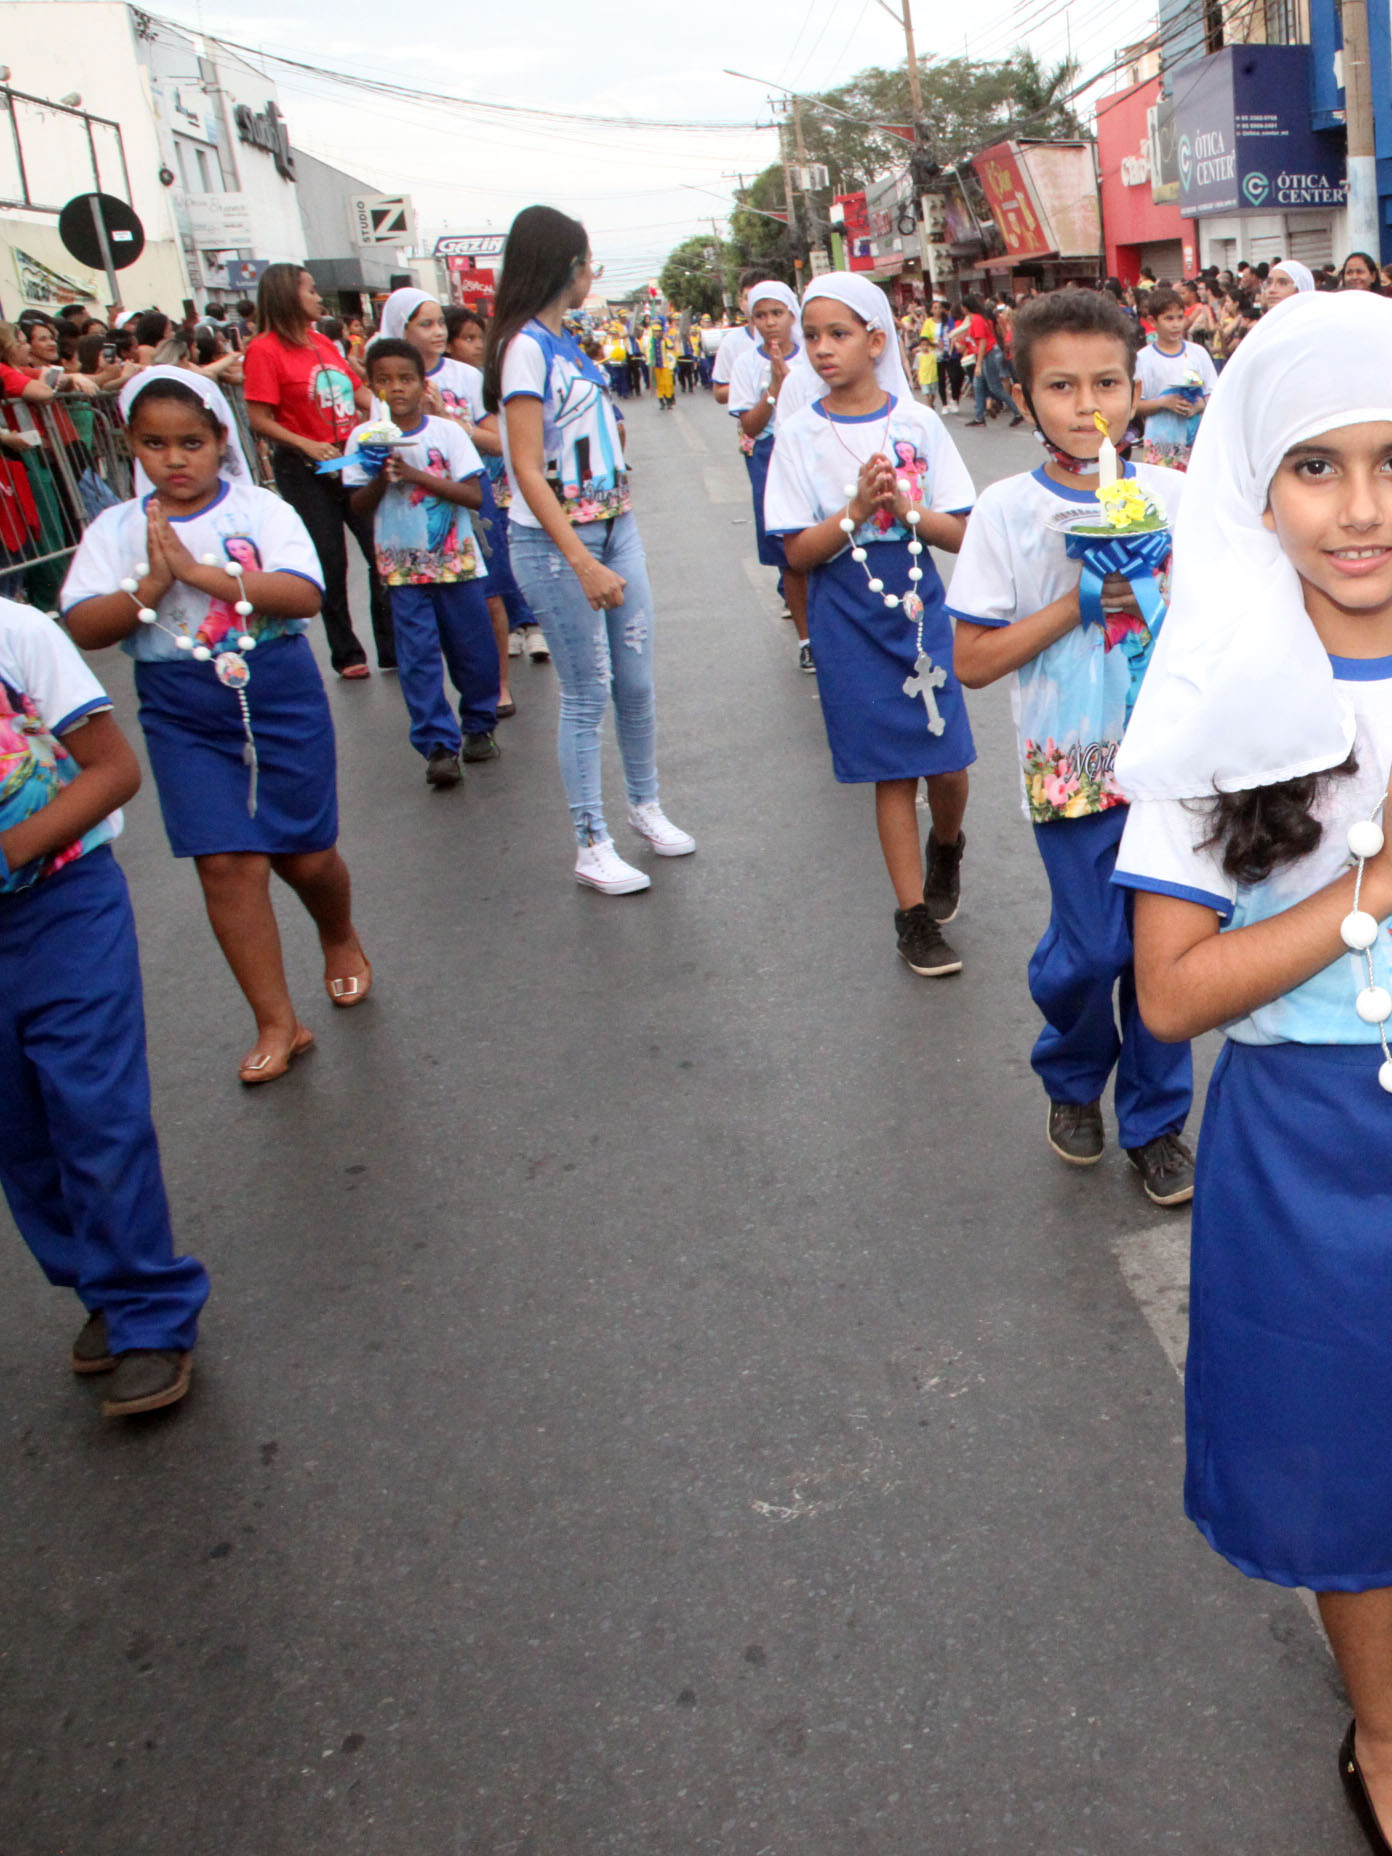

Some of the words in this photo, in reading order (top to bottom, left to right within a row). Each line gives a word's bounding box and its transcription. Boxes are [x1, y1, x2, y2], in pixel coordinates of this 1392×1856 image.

[1195, 130, 1225, 160] ÓTICA
[1197, 157, 1235, 186] CENTER
[1277, 171, 1329, 189] ÓTICA
[1277, 189, 1344, 204] CENTER
[357, 201, 371, 243] STUDIO
